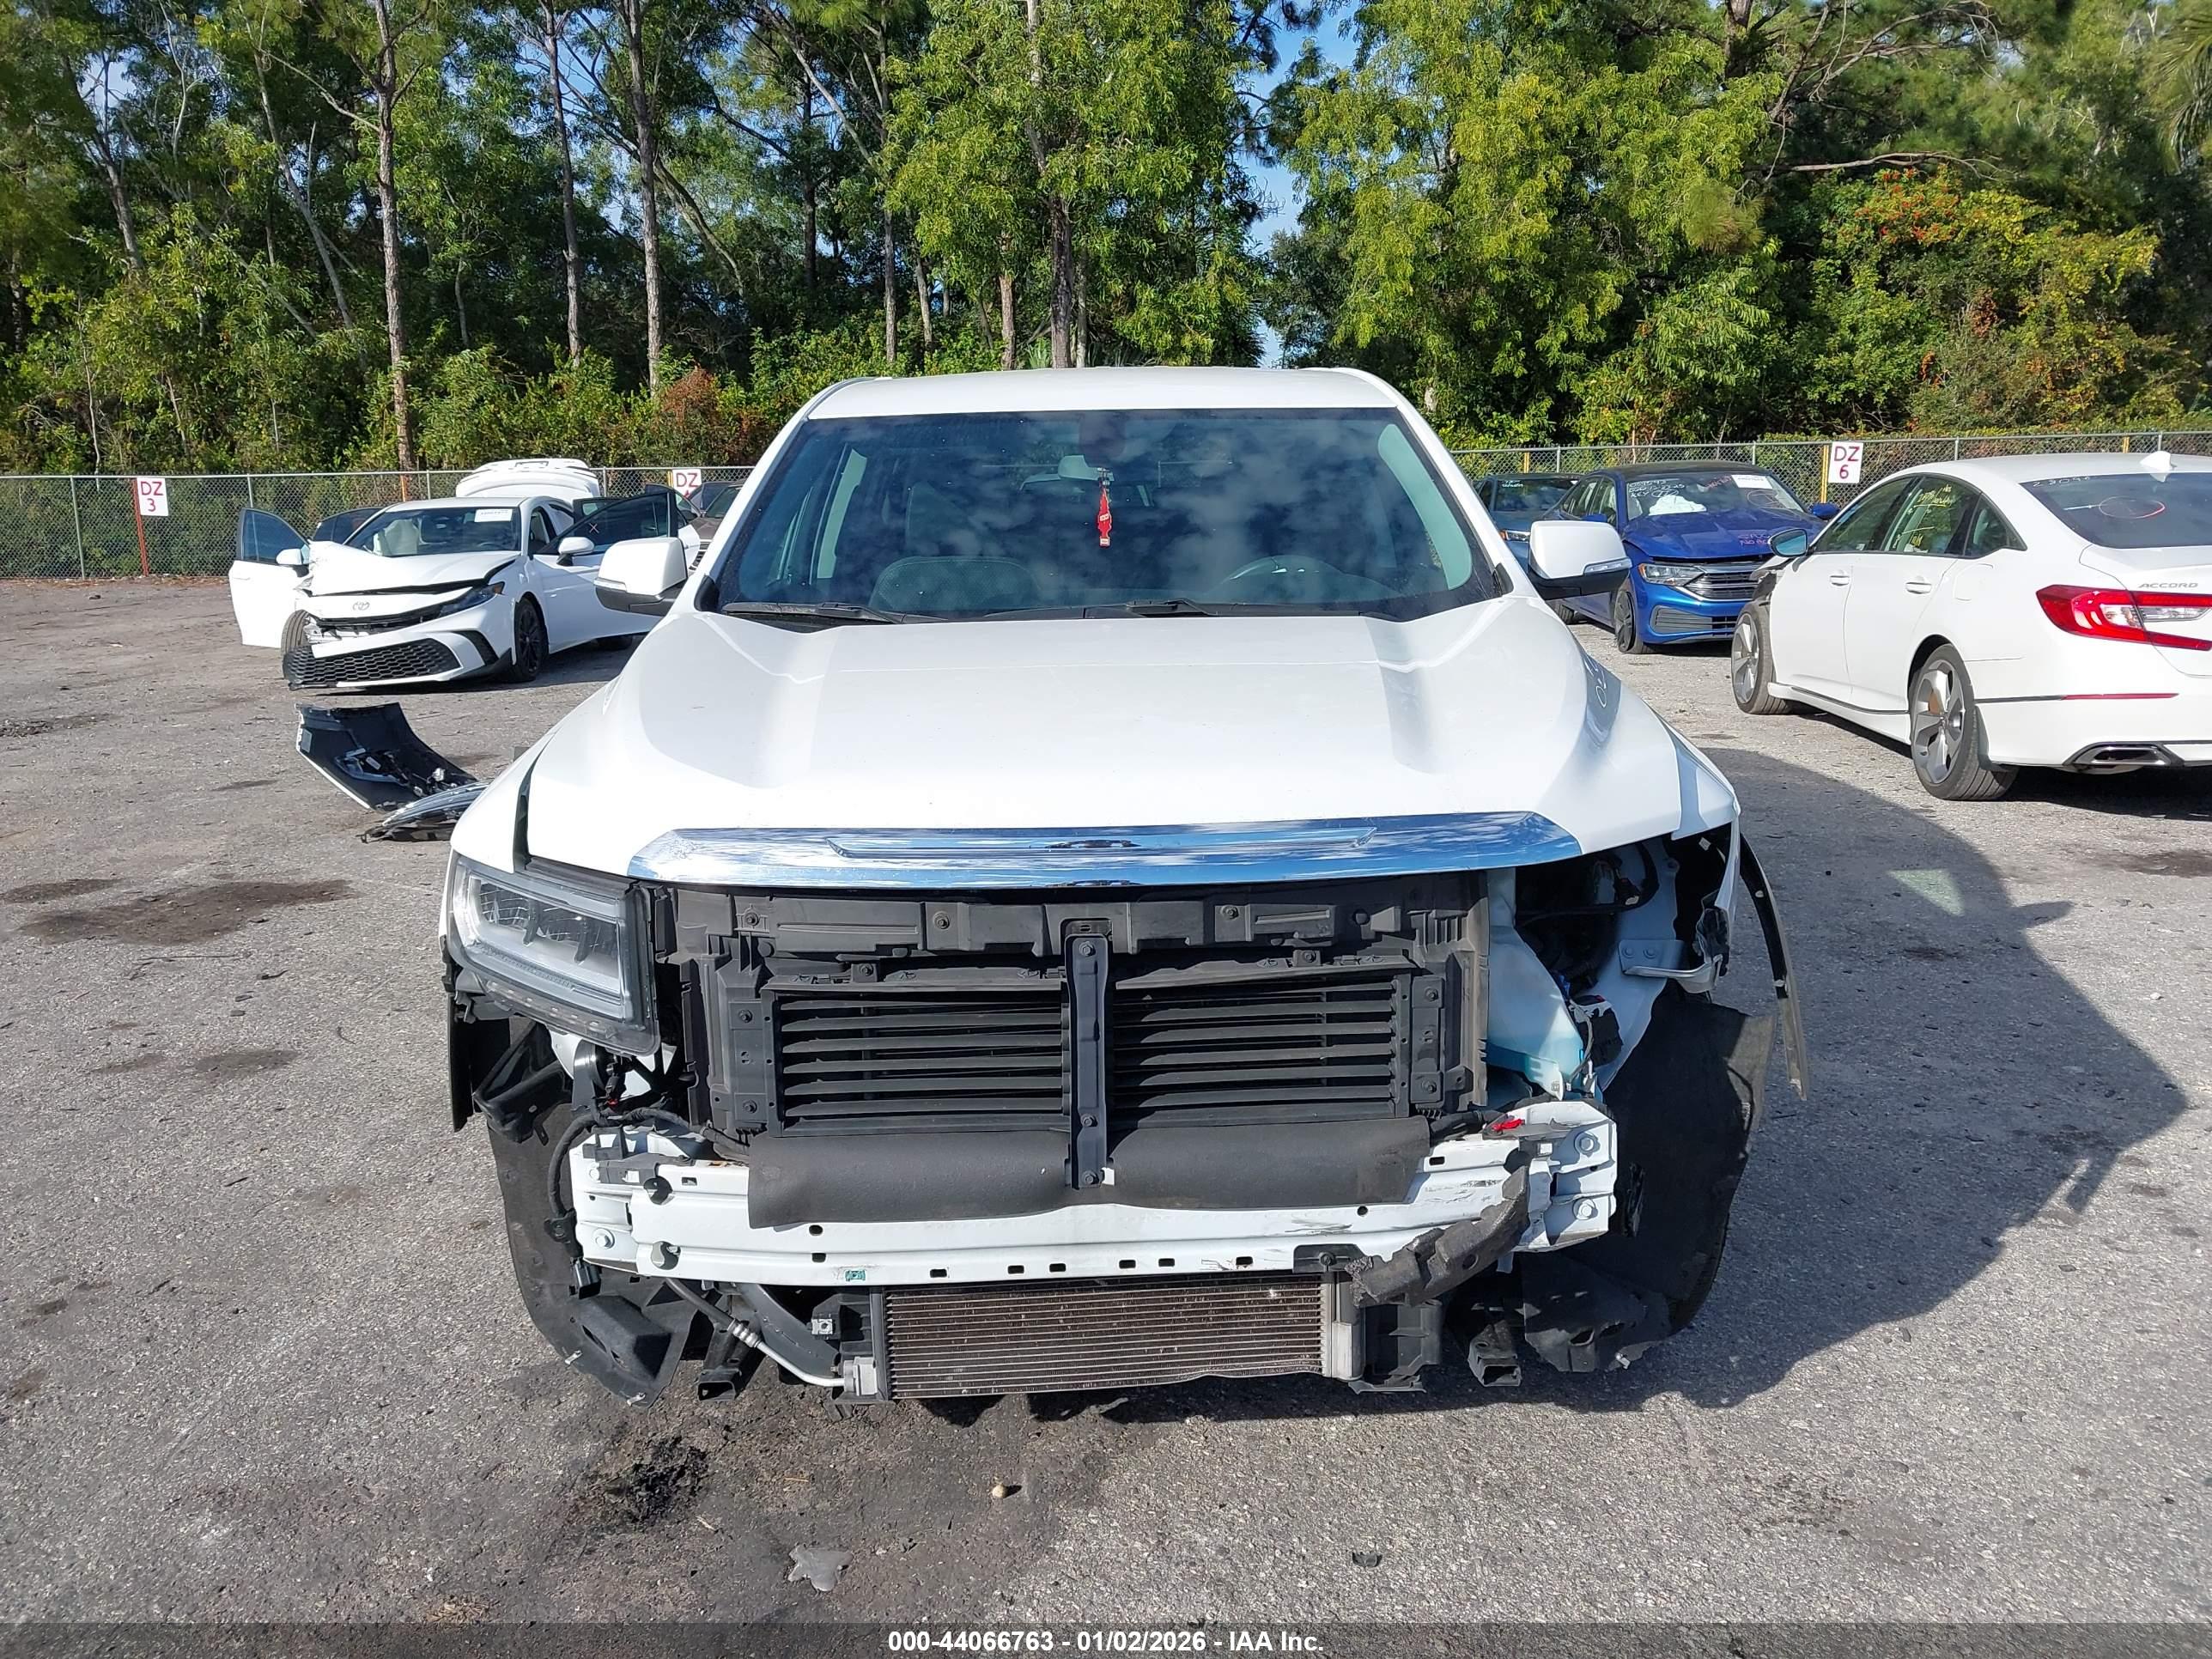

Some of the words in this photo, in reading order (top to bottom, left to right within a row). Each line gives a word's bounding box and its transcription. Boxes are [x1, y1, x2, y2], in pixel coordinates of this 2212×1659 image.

[1833, 446, 1860, 462] DZ
[676, 472, 699, 488] DZ
[1839, 464, 1850, 480] 6
[141, 481, 164, 495] DZ
[147, 498, 156, 513] 3
